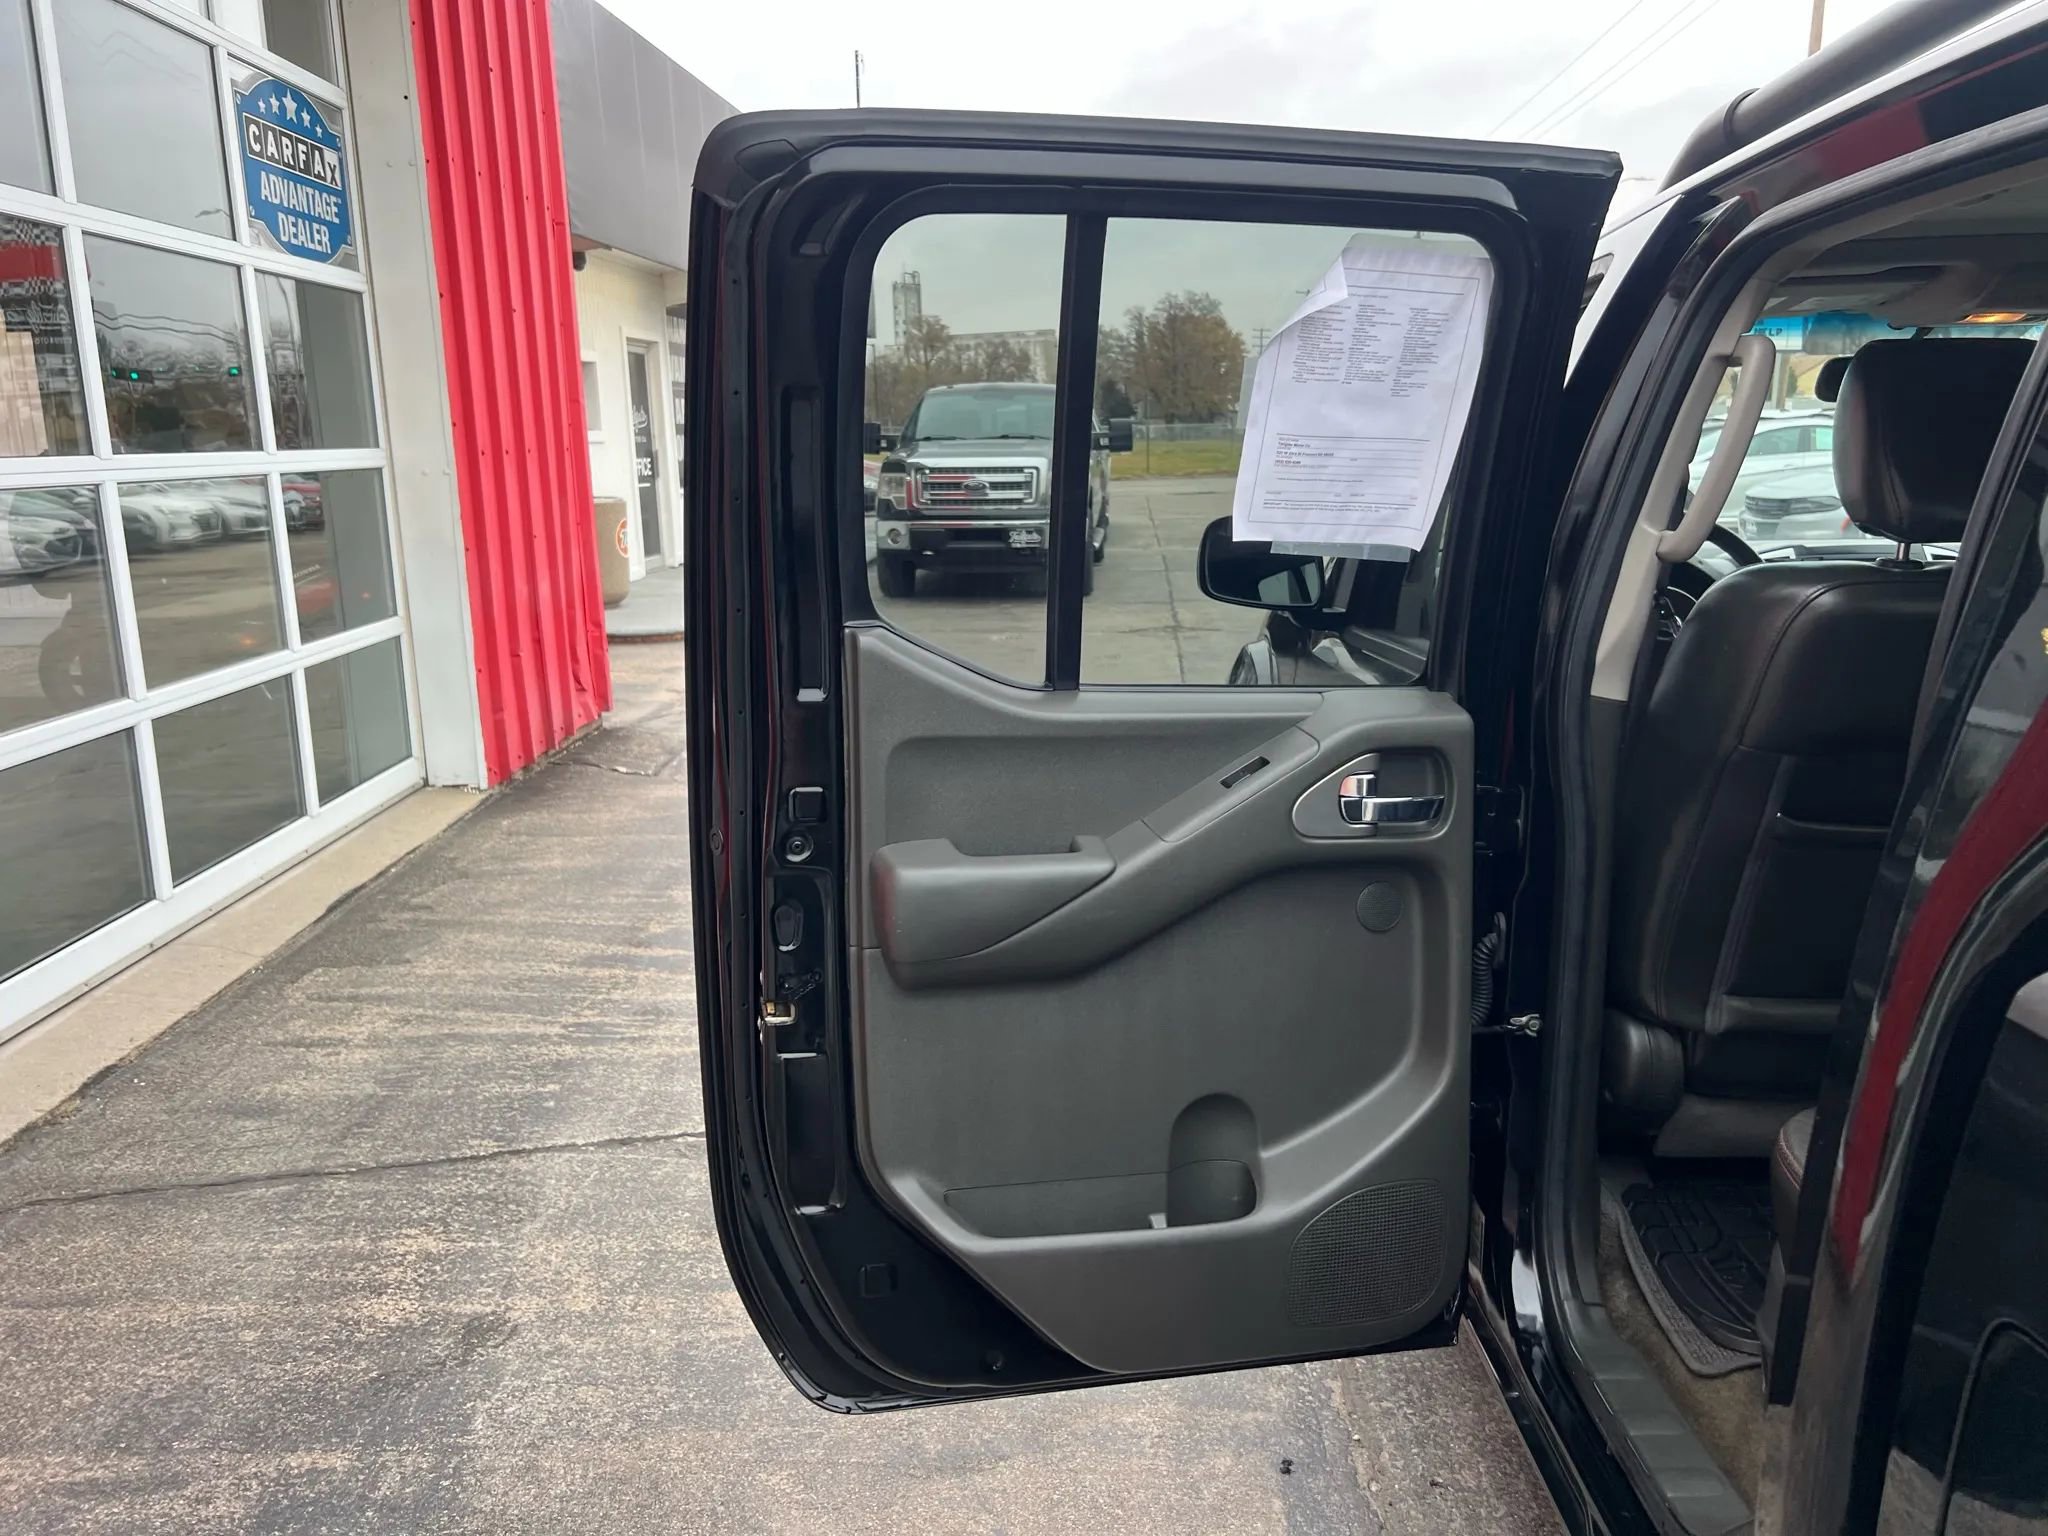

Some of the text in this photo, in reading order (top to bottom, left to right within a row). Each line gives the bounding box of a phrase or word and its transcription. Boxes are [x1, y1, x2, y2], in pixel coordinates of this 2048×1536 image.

[248, 122, 340, 187] CARFAX
[260, 170, 340, 224] ADVANTAGE
[277, 211, 332, 254] DEALER
